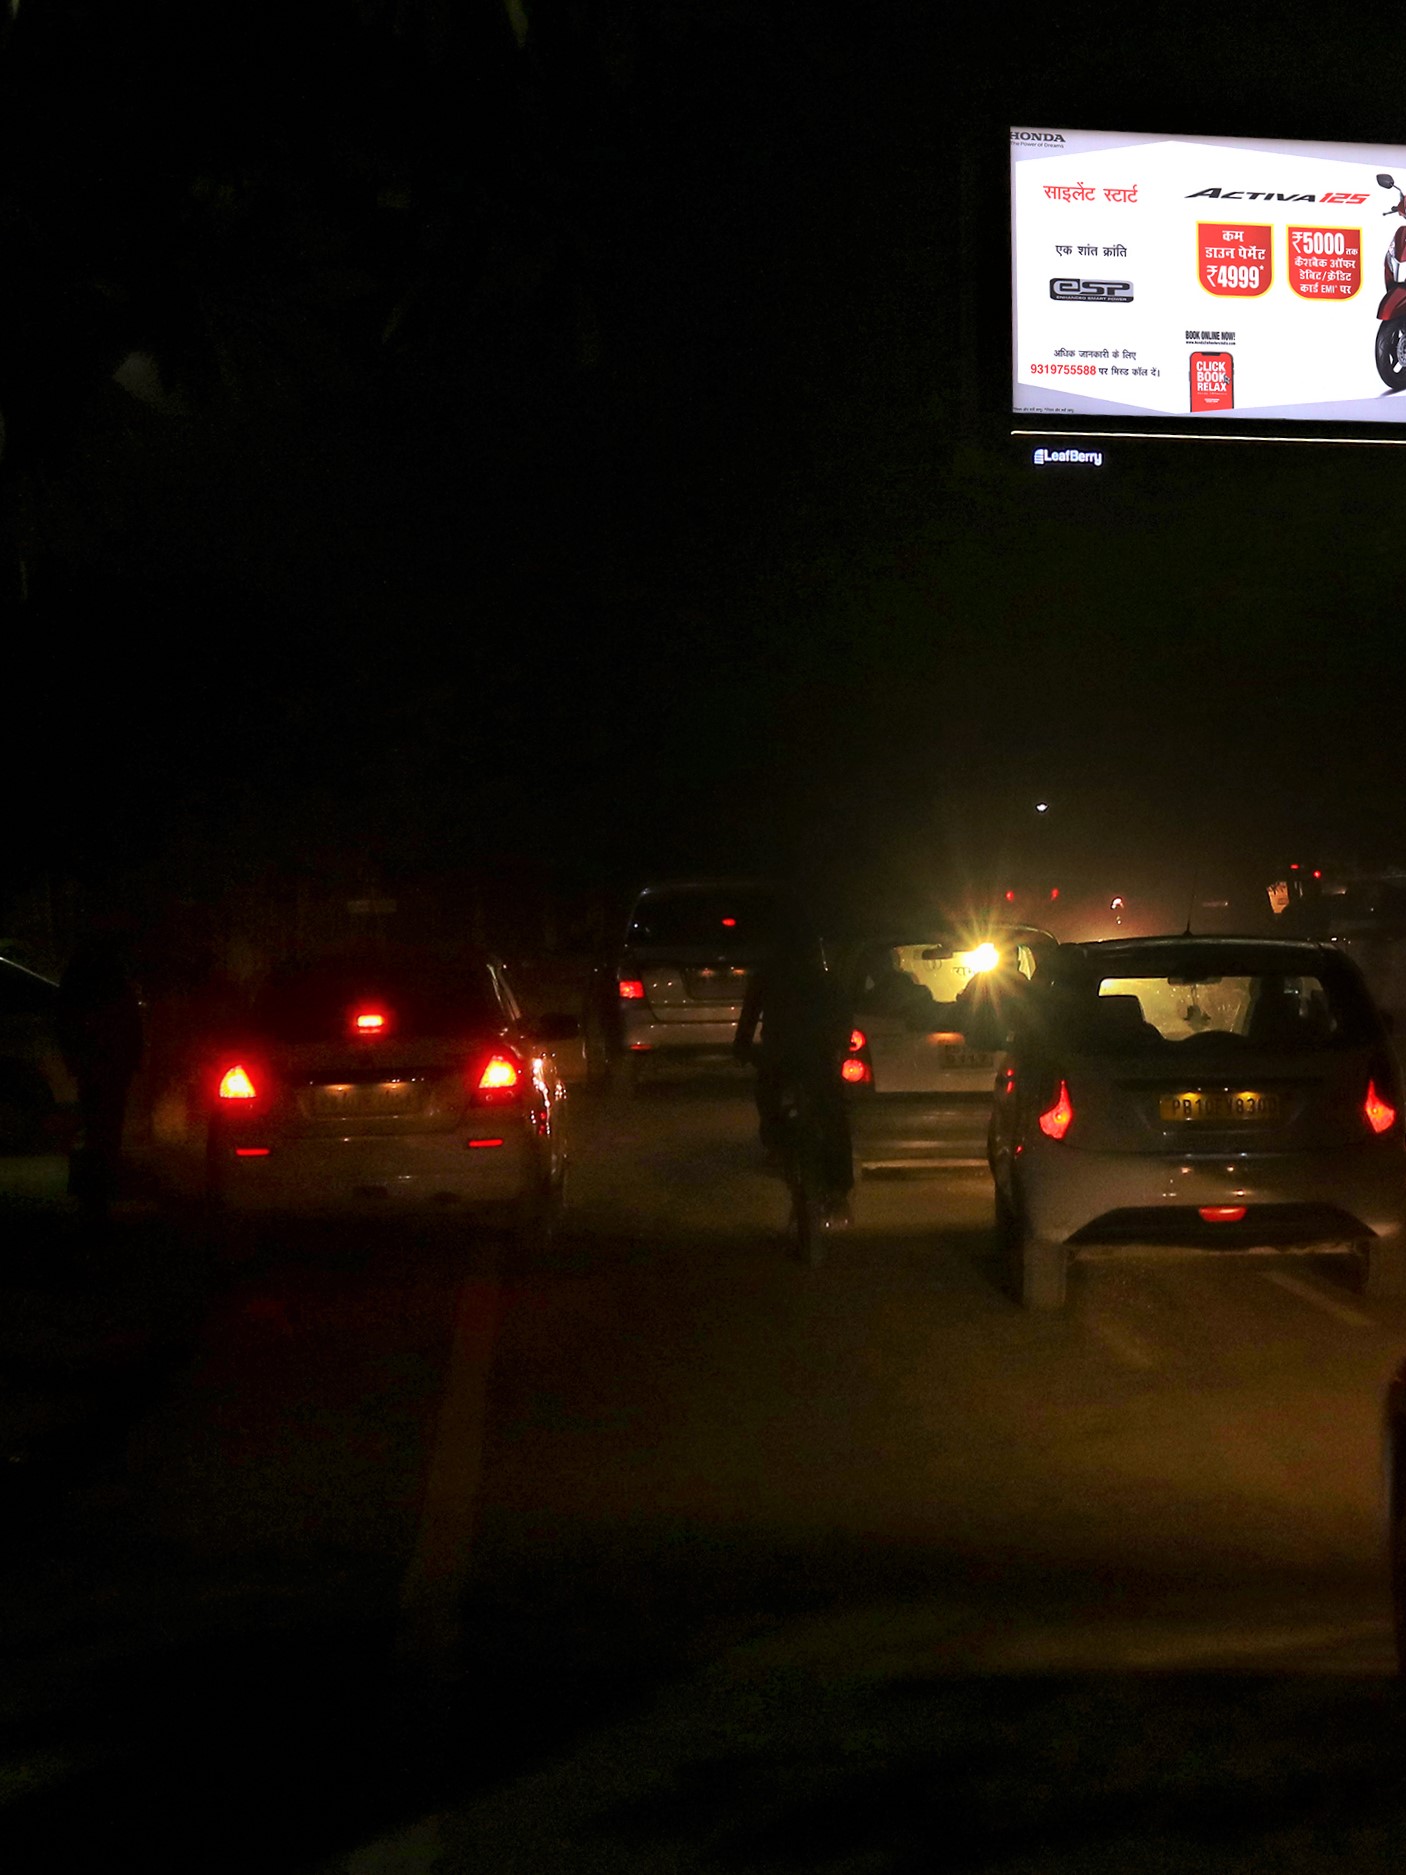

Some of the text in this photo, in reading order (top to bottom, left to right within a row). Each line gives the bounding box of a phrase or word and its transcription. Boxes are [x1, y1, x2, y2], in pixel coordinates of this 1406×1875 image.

[1010, 131, 1066, 143] HONDA
[1043, 181, 1138, 204] साइलेंट स्टार्ट
[1318, 192, 1371, 205] 125
[1222, 229, 1245, 242] कम
[1055, 242, 1128, 258] एक शांत क्रांति
[1291, 231, 1359, 256] ₹5000 तक
[1204, 244, 1267, 260] डाउन पेमेंट
[1329, 257, 1356, 269] ऑफर
[1299, 282, 1319, 293] कार्ड
[1339, 285, 1353, 295] पर
[1185, 330, 1236, 341] BOOK ONLINE NOW!
[1054, 347, 1137, 360] अधिक जानकारी के लिए
[1030, 363, 1097, 376] 9319755588
[1098, 367, 1108, 376] पर
[1111, 365, 1129, 376] मिस्ड
[1132, 366, 1148, 377] कॉल
[1196, 360, 1226, 372] CLICK
[1197, 371, 1226, 382] BOOK
[1197, 382, 1227, 392] RELAX
